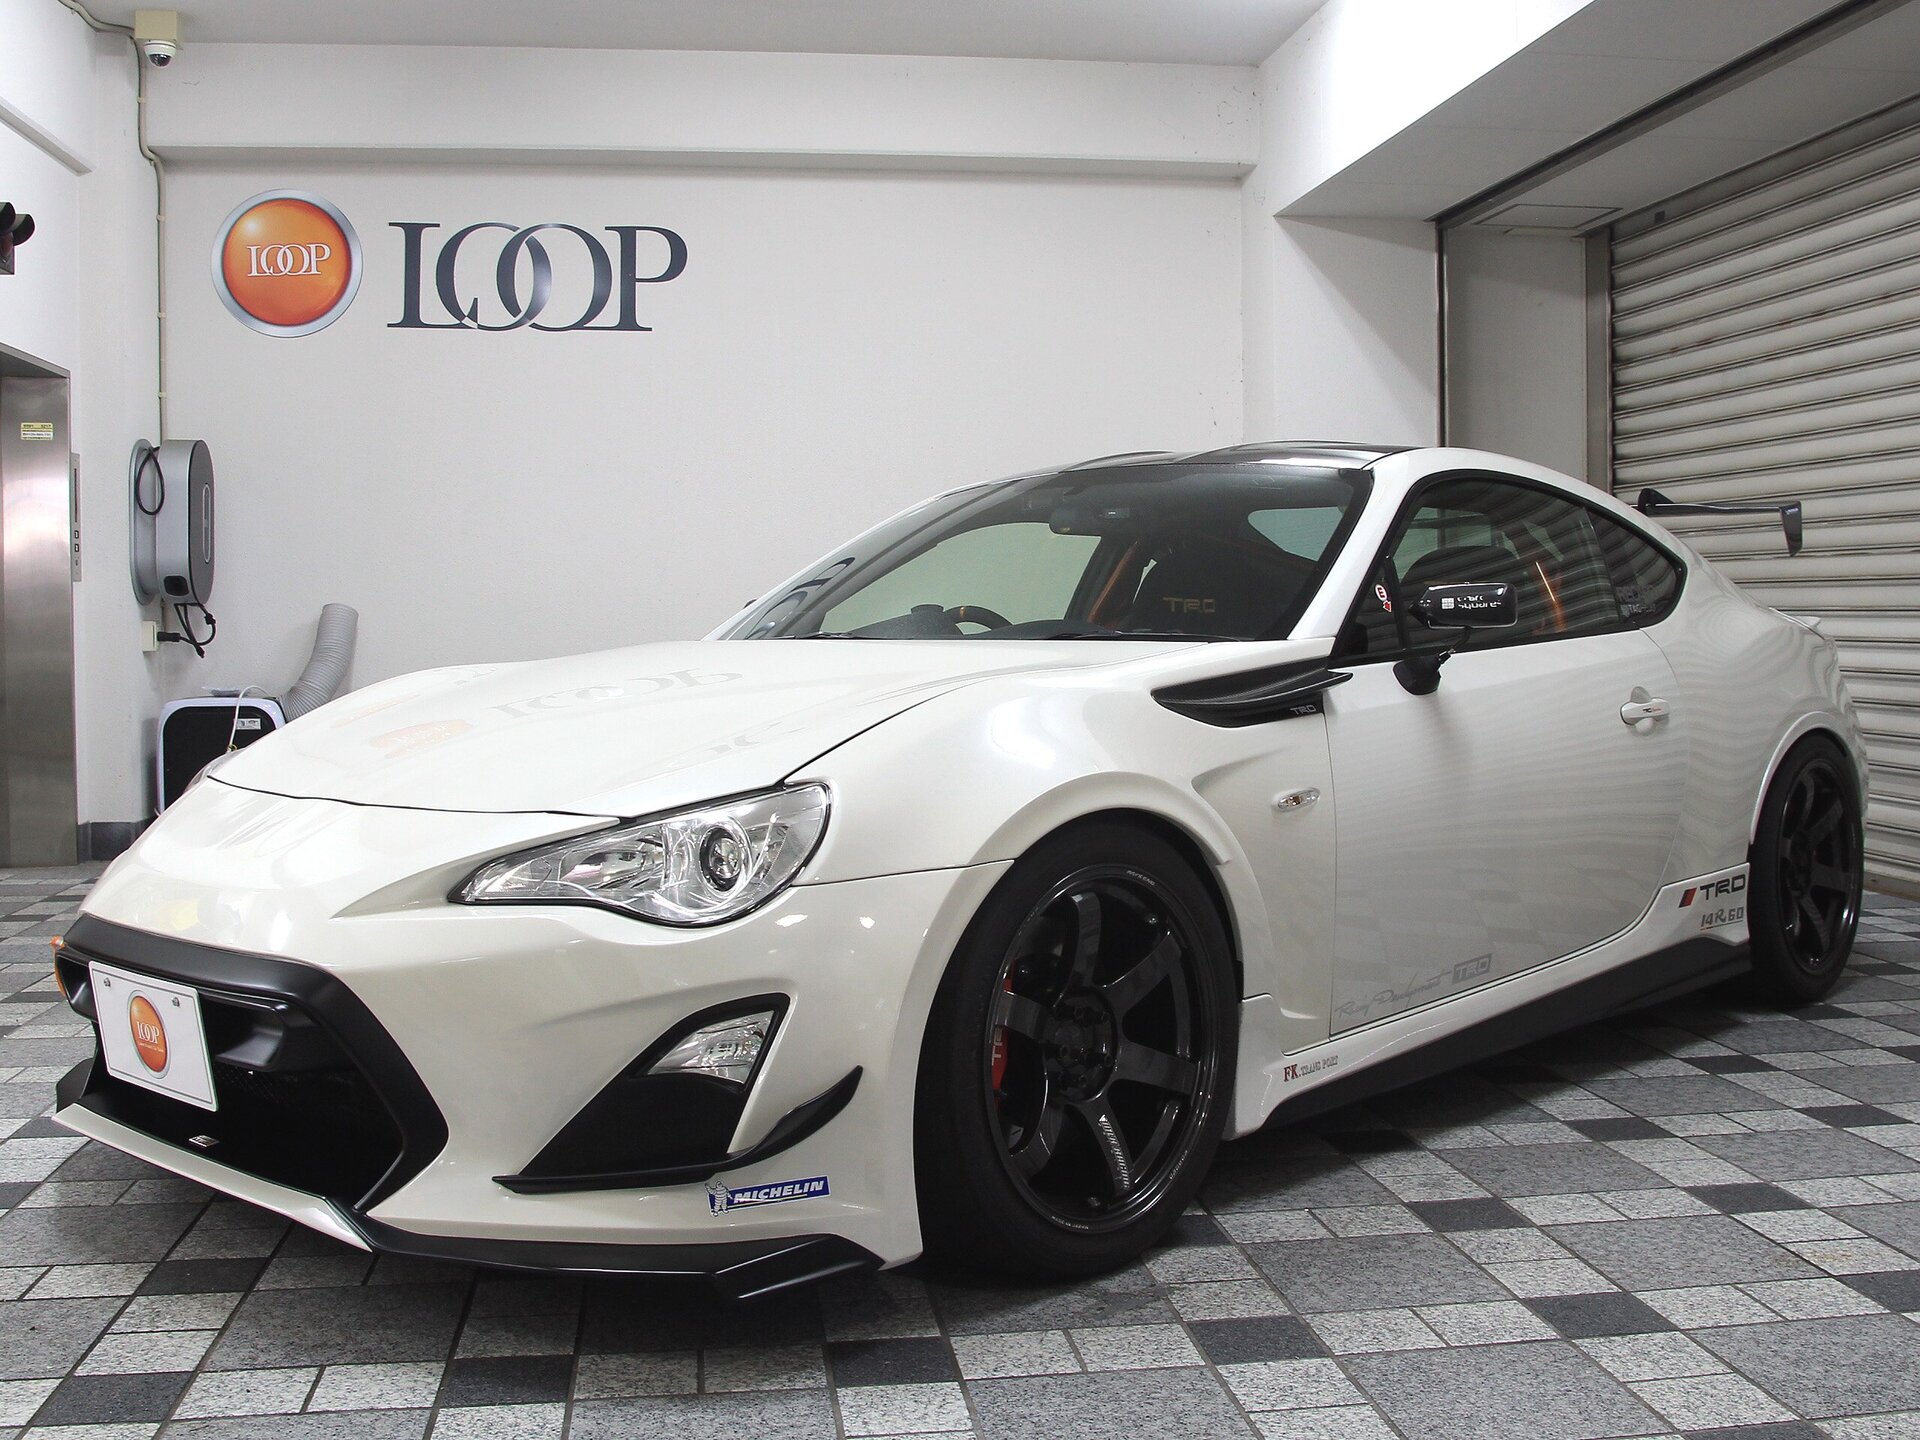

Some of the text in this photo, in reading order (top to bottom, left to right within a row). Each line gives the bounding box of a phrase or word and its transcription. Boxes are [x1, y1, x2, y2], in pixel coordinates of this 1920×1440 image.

[247, 242, 332, 278] LOOP
[387, 221, 688, 332] LOOP
[1162, 597, 1216, 613] TRD
[1290, 704, 1317, 715] TRD
[1700, 874, 1746, 900] TRD
[1455, 955, 1492, 981] TRD
[136, 1021, 160, 1044] LOOP
[733, 1180, 825, 1204] MICHELIN
